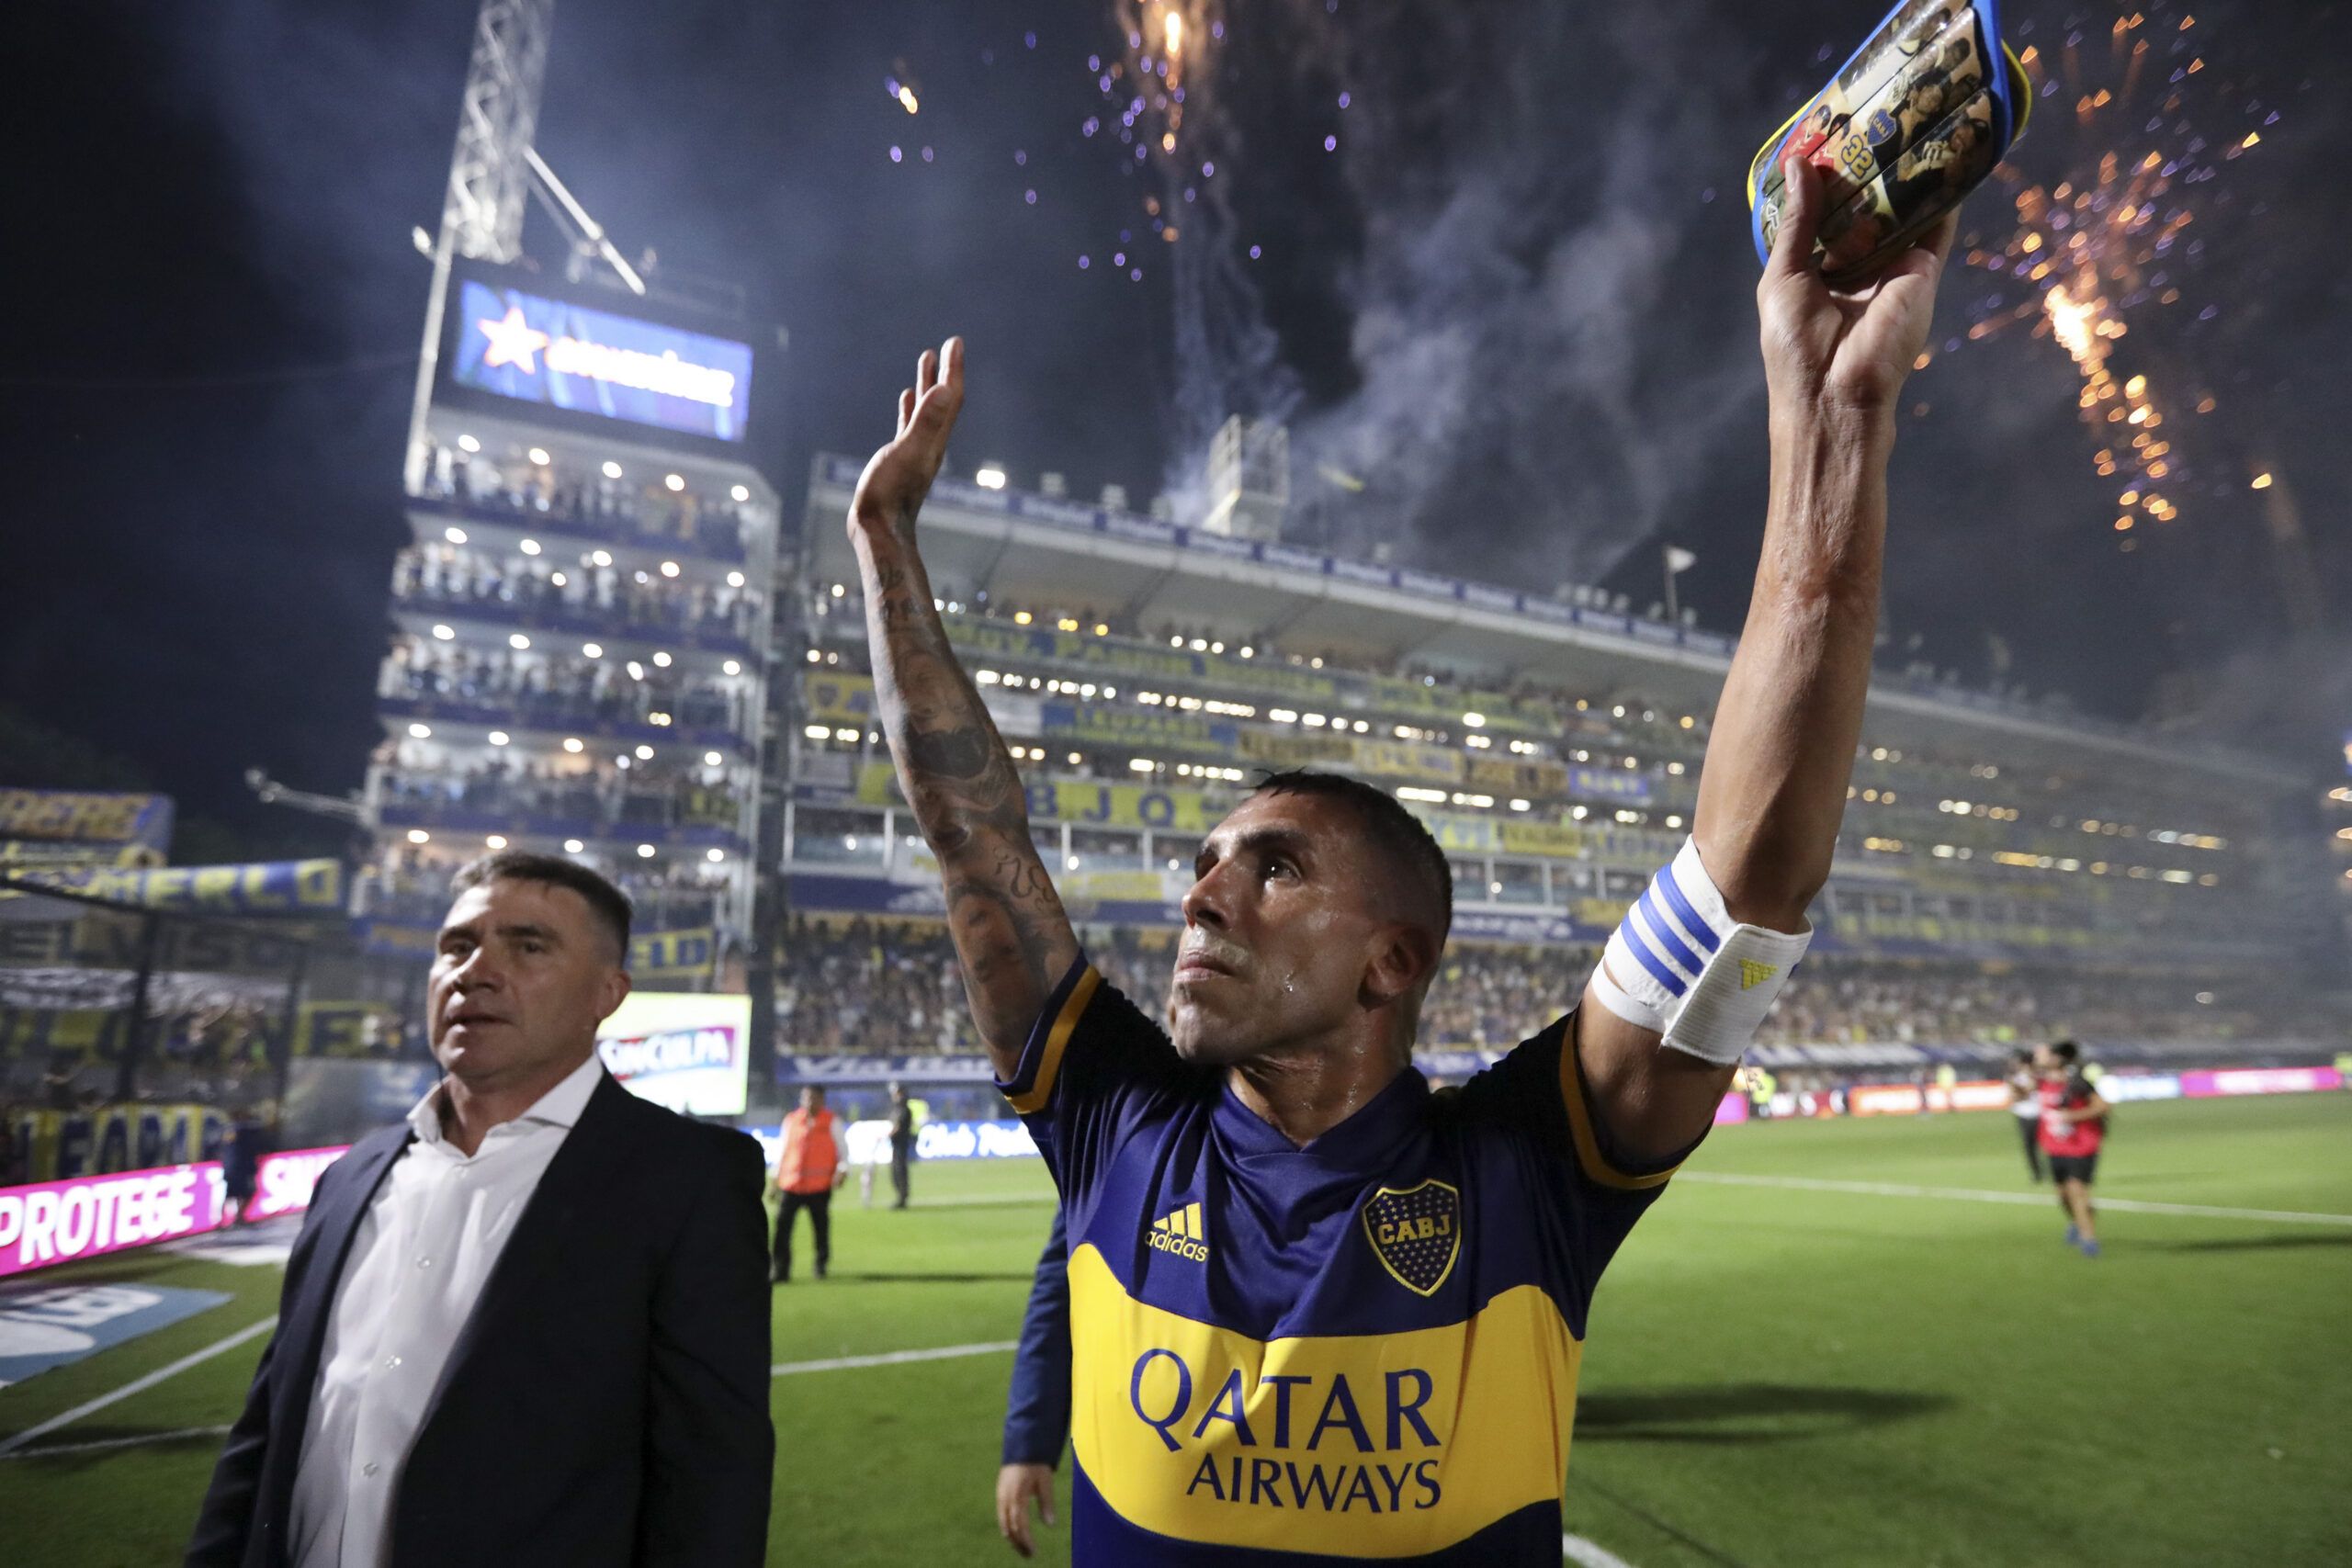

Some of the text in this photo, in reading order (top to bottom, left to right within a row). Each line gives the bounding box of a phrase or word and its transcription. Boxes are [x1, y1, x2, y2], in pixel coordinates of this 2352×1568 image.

[1842, 135, 1874, 178] 32
[1145, 1229, 1209, 1262] adidas
[1379, 1215, 1451, 1245] CABJ
[1130, 1348, 1442, 1453] QATAR
[1186, 1452, 1442, 1514] AIRWAYS
